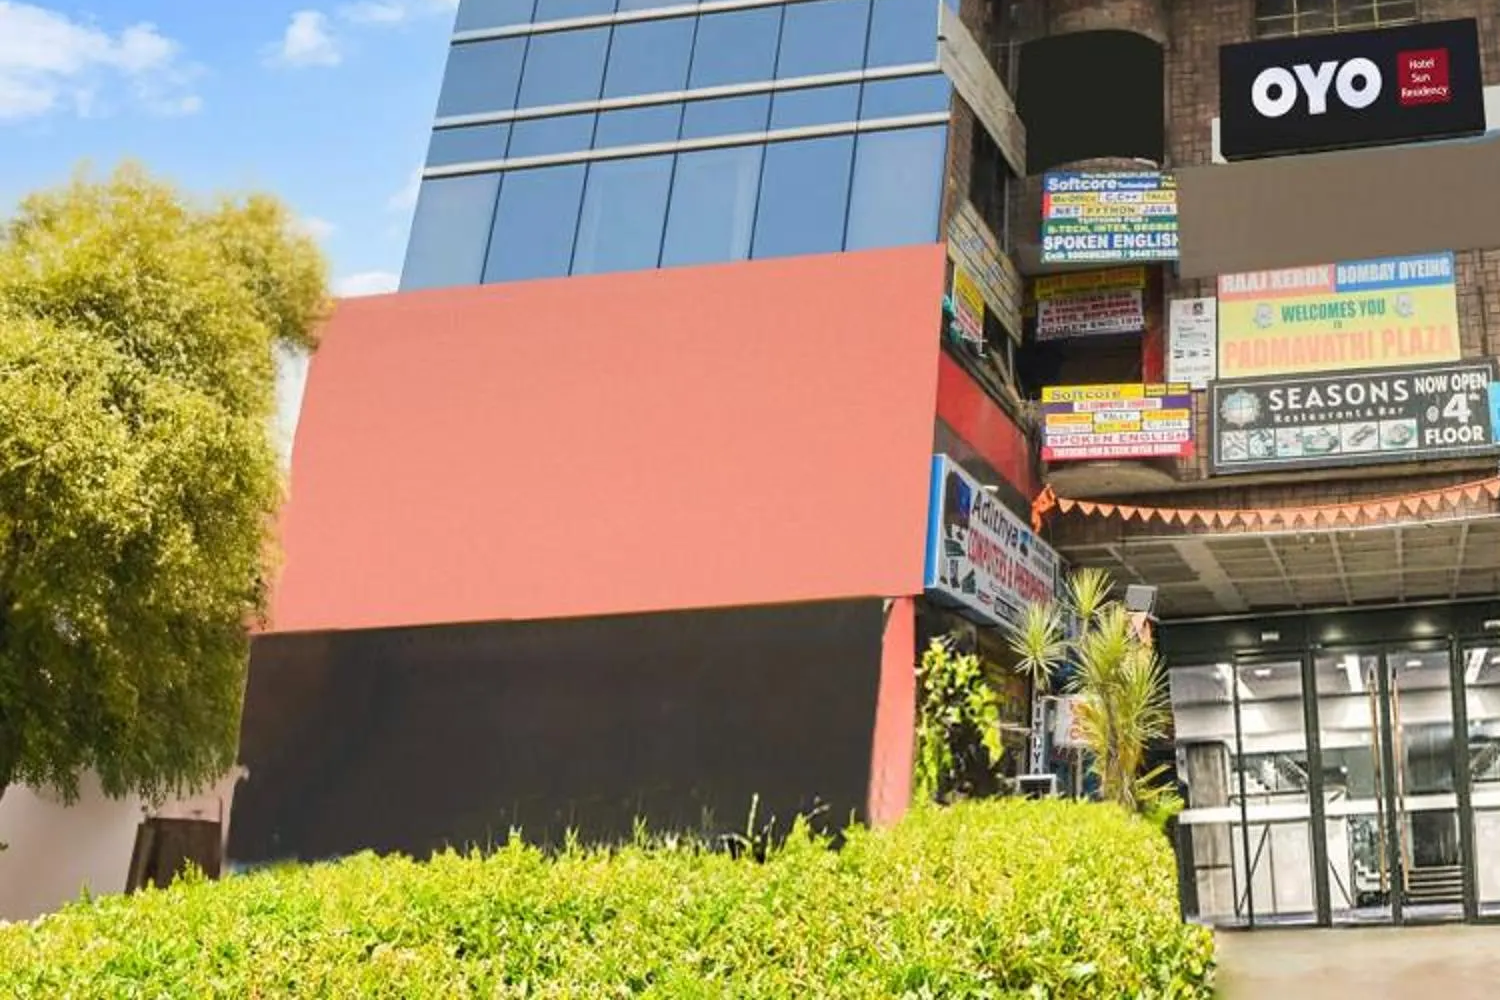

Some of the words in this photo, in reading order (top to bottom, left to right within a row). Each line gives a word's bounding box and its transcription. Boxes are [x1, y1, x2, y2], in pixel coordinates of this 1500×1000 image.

[1409, 58, 1435, 69] Hotel
[1411, 73, 1431, 83] Sun
[1251, 57, 1382, 118] OYO
[1401, 86, 1448, 99] Residency
[1048, 177, 1117, 191] Softcore
[1143, 204, 1172, 214] JAVA
[1044, 234, 1109, 250] SPOKEN
[1337, 261, 1396, 285] BOMBAY
[1399, 256, 1451, 280] DYEING
[1281, 300, 1357, 324] WELCOMES
[1360, 298, 1386, 317] YOU
[1225, 329, 1374, 370] PADMAVATHI
[1382, 324, 1453, 360] PLAZA
[1268, 379, 1410, 411] SEASONS
[1414, 375, 1448, 395] NOW
[1451, 371, 1488, 391] OPEN
[1274, 409, 1361, 423] Restaurant
[1379, 406, 1406, 416] Bar
[1050, 434, 1113, 445] SPOKEN
[1119, 432, 1187, 443] ENGLISH
[1424, 425, 1486, 445] FLOOR
[972, 490, 1019, 549] Adithya
